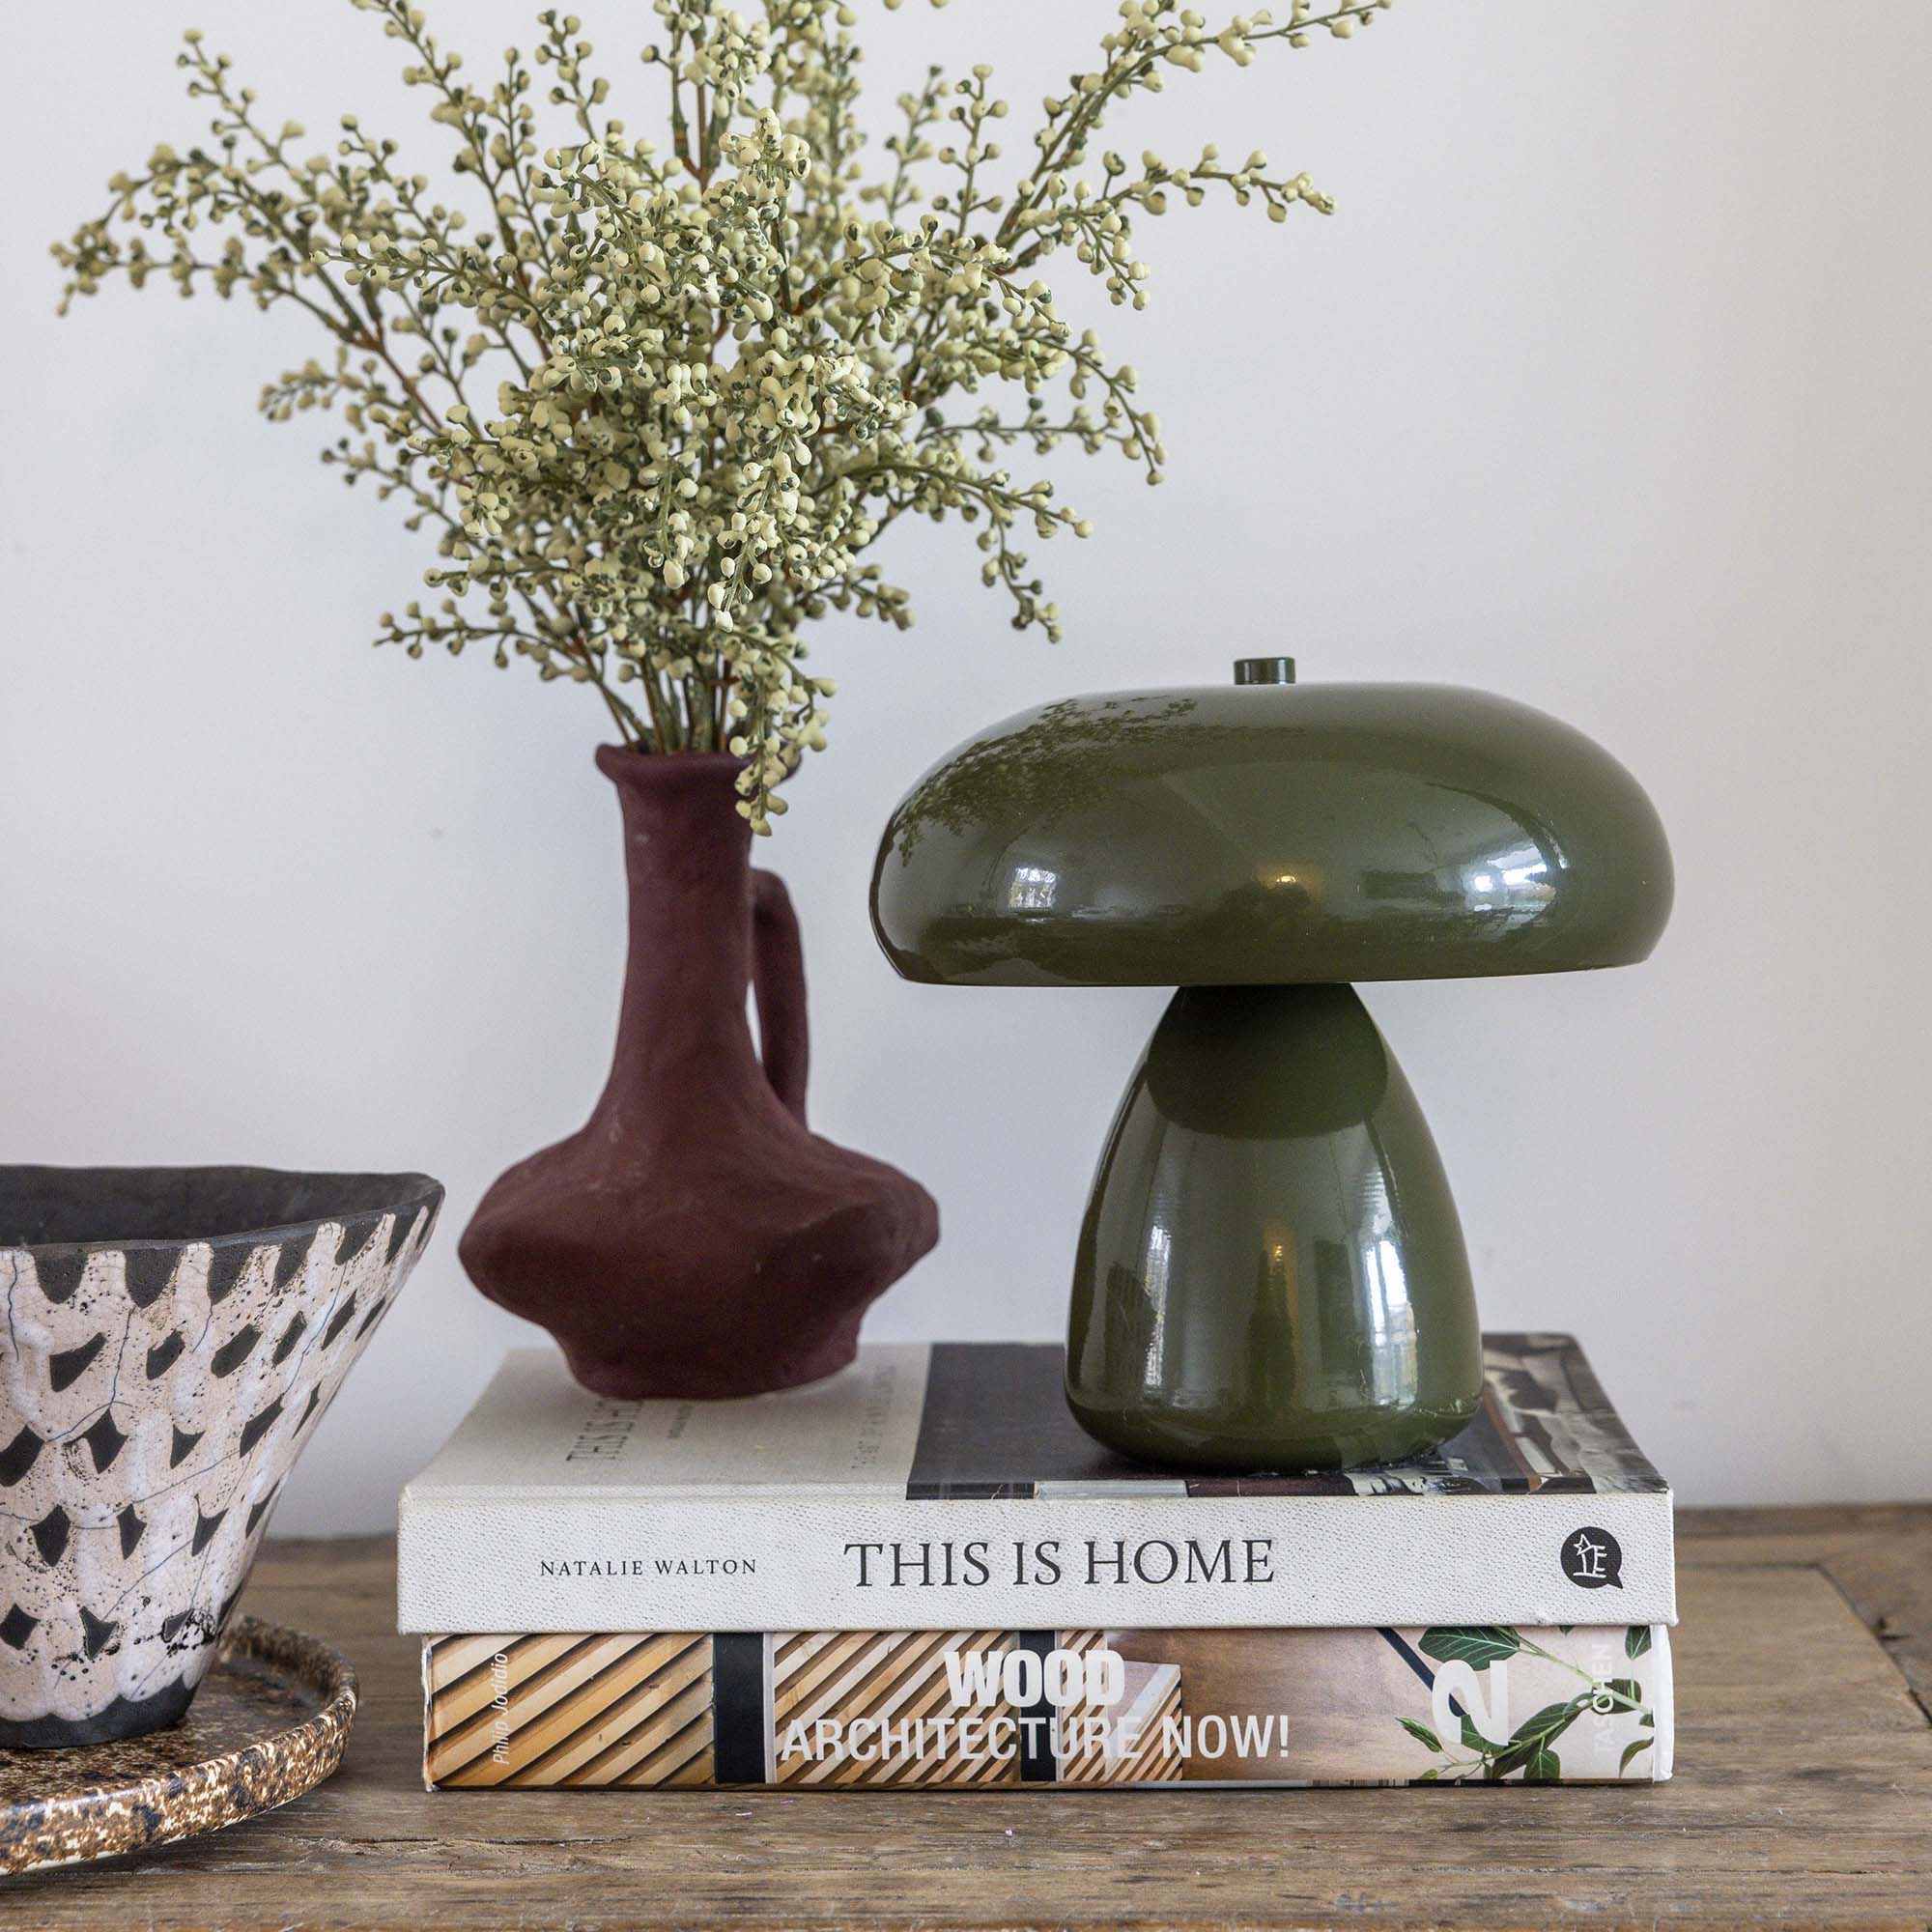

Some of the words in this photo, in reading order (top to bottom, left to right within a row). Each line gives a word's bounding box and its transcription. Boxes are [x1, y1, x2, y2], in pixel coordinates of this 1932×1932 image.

[540, 1560, 643, 1576] NATALIE
[655, 1559, 756, 1575] WALTON
[843, 1542, 990, 1587] THIS
[1012, 1541, 1062, 1585] IS
[1084, 1539, 1275, 1585] HOME
[491, 1653, 509, 1716] Jodidio
[943, 1649, 1126, 1708] WOOD
[1433, 1659, 1509, 1747] 2
[1592, 1644, 1616, 1754] TASCHEN
[492, 1720, 510, 1765] Philip
[781, 1716, 1143, 1761] ARCHITECTURE
[1162, 1715, 1290, 1759] NOW!
